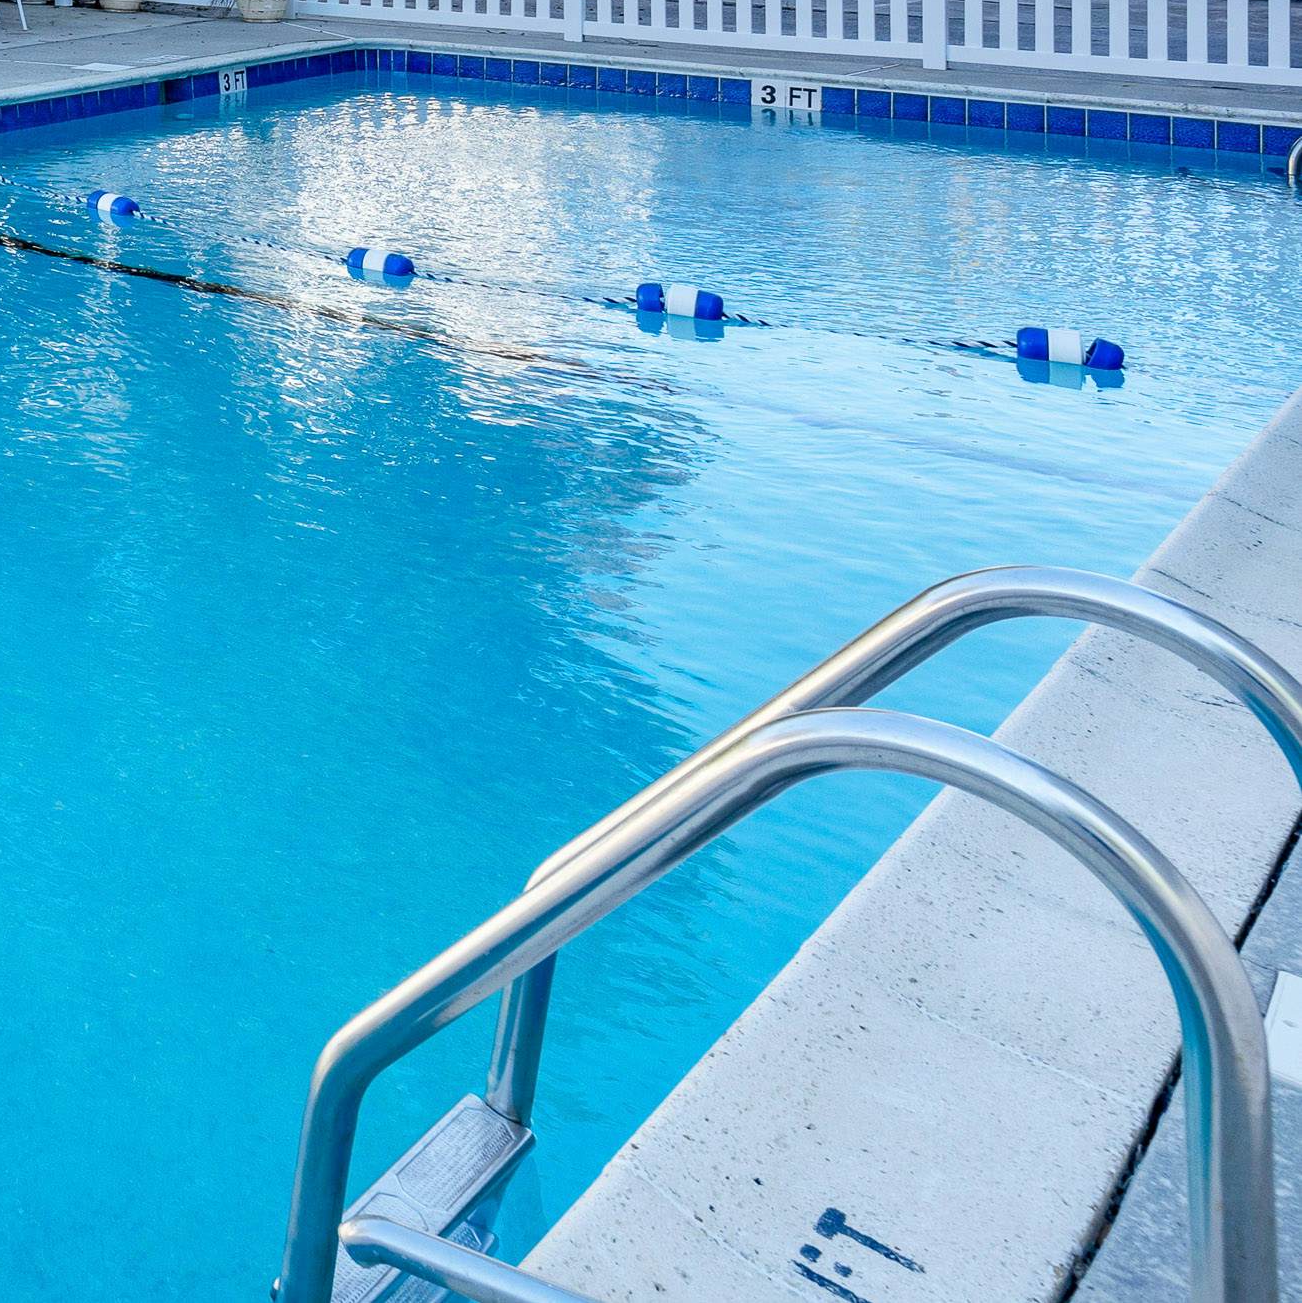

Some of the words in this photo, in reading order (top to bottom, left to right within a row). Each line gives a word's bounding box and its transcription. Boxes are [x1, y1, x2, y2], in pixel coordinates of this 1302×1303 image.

[223, 73, 231, 91] 3
[234, 70, 245, 90] FT
[761, 85, 776, 104] 3
[789, 86, 817, 108] FT
